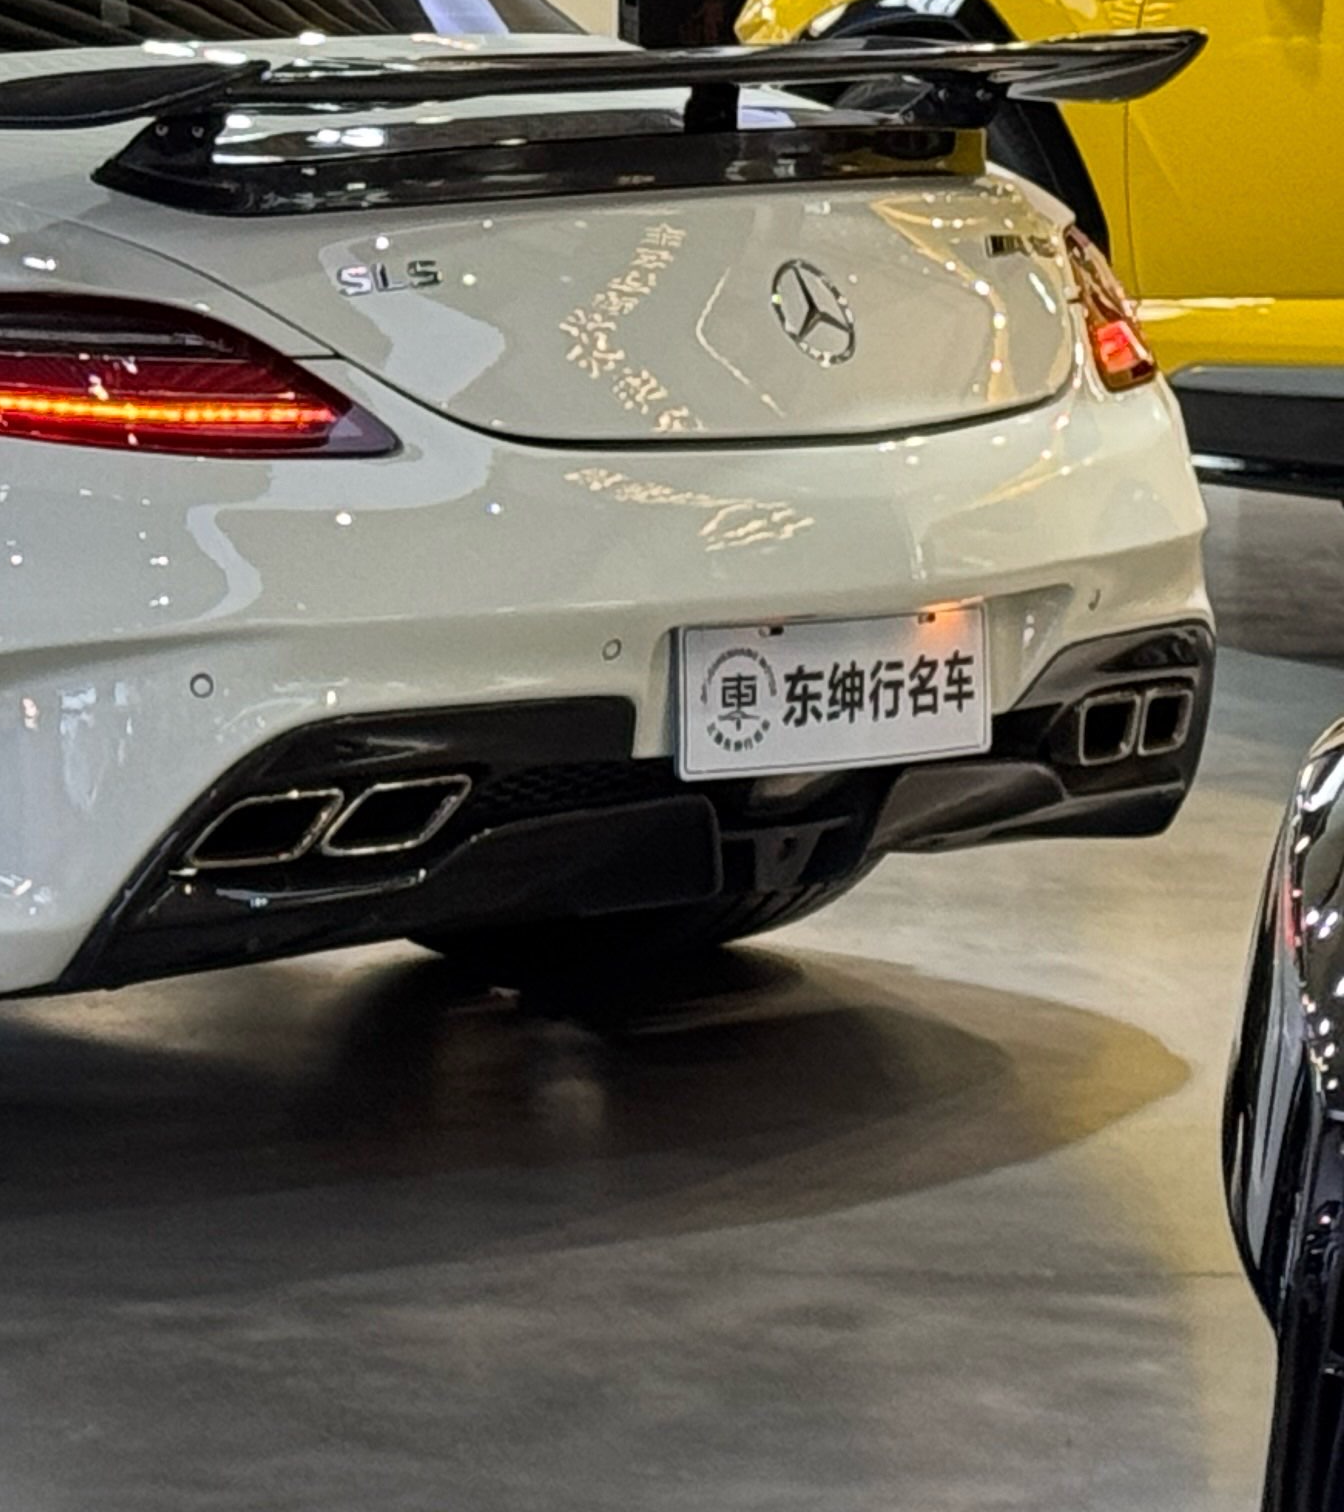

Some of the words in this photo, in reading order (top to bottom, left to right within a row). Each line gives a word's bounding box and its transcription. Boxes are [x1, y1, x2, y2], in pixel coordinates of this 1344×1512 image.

[336, 260, 443, 297] SLS
[782, 649, 976, 728] 东绅行名车
